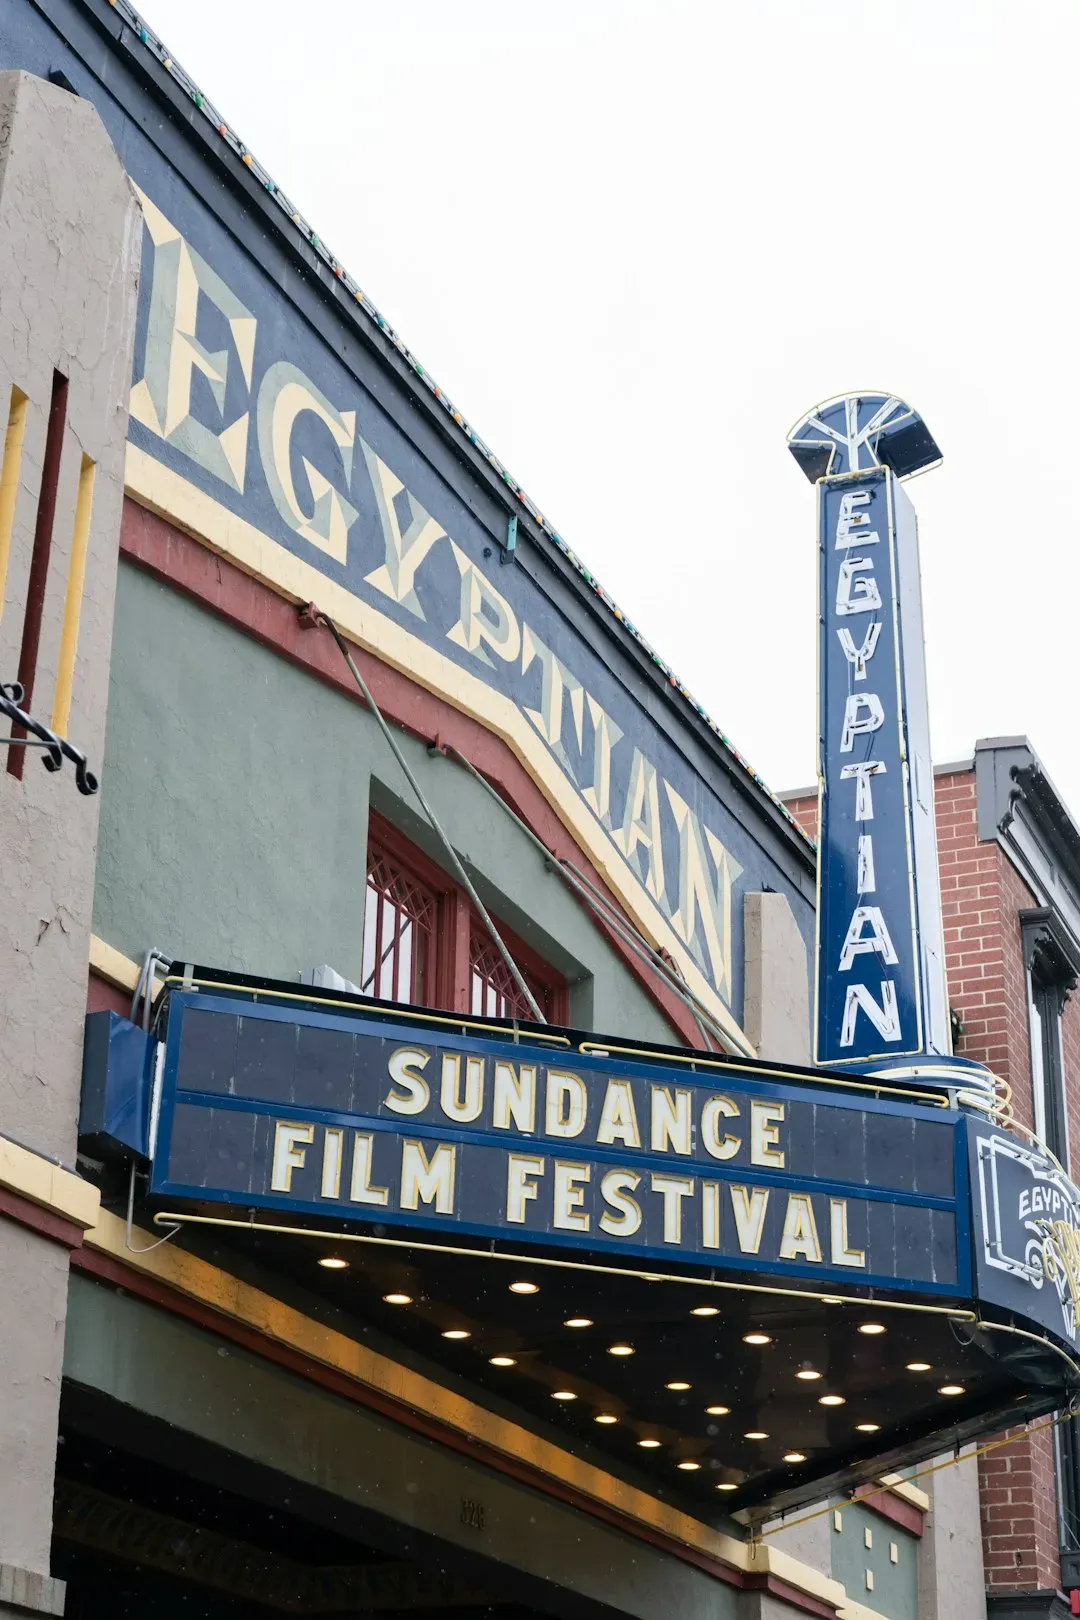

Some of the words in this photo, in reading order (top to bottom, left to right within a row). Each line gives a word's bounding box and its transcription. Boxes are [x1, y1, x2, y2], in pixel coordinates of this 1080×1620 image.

[129, 177, 744, 1006] EGYPTIAN
[835, 491, 902, 1046] EGYPTIAN
[271, 1119, 457, 1214] FILM
[506, 1152, 866, 1268] FESTIVAL
[383, 1047, 786, 1169] SUNDANCE
